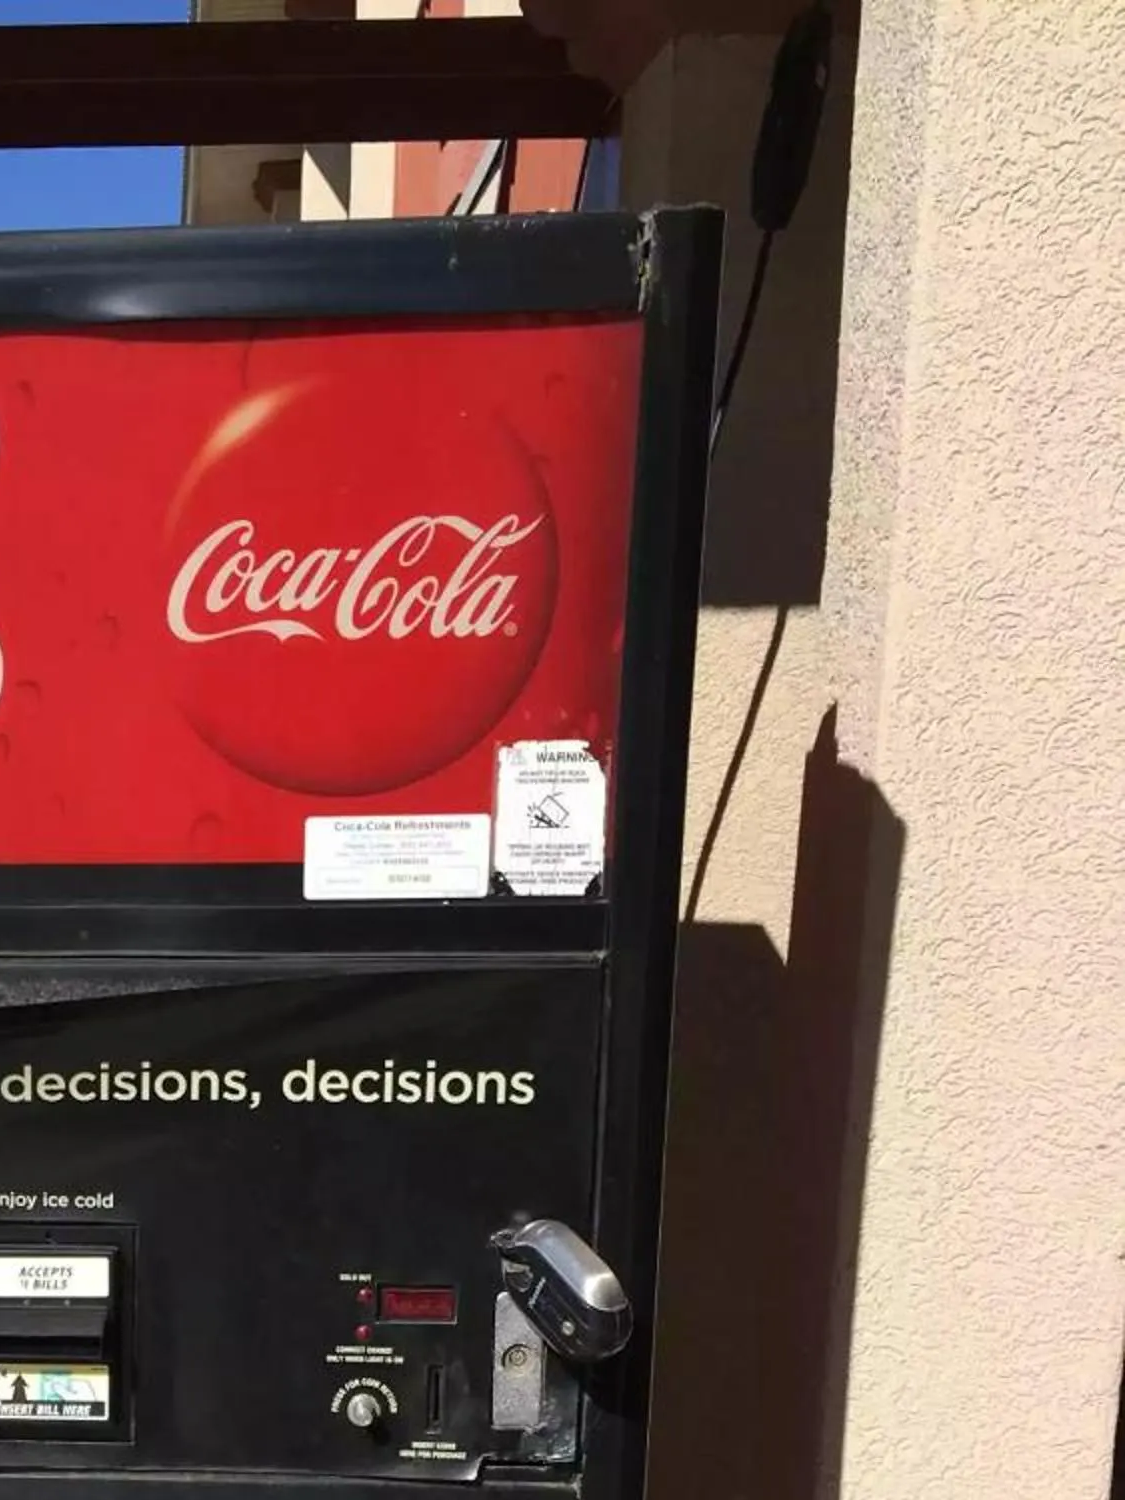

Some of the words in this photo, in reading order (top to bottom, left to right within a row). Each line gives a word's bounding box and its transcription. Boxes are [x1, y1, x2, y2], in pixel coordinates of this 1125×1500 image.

[167, 513, 546, 642] Coca-Cola
[0, 1061, 261, 1108] decisions,
[282, 1059, 535, 1104] decisions
[42, 1191, 69, 1207] ice
[74, 1192, 114, 1209] cold
[18, 1266, 73, 1277] ACCEPTS
[36, 1404, 60, 1416] BILL
